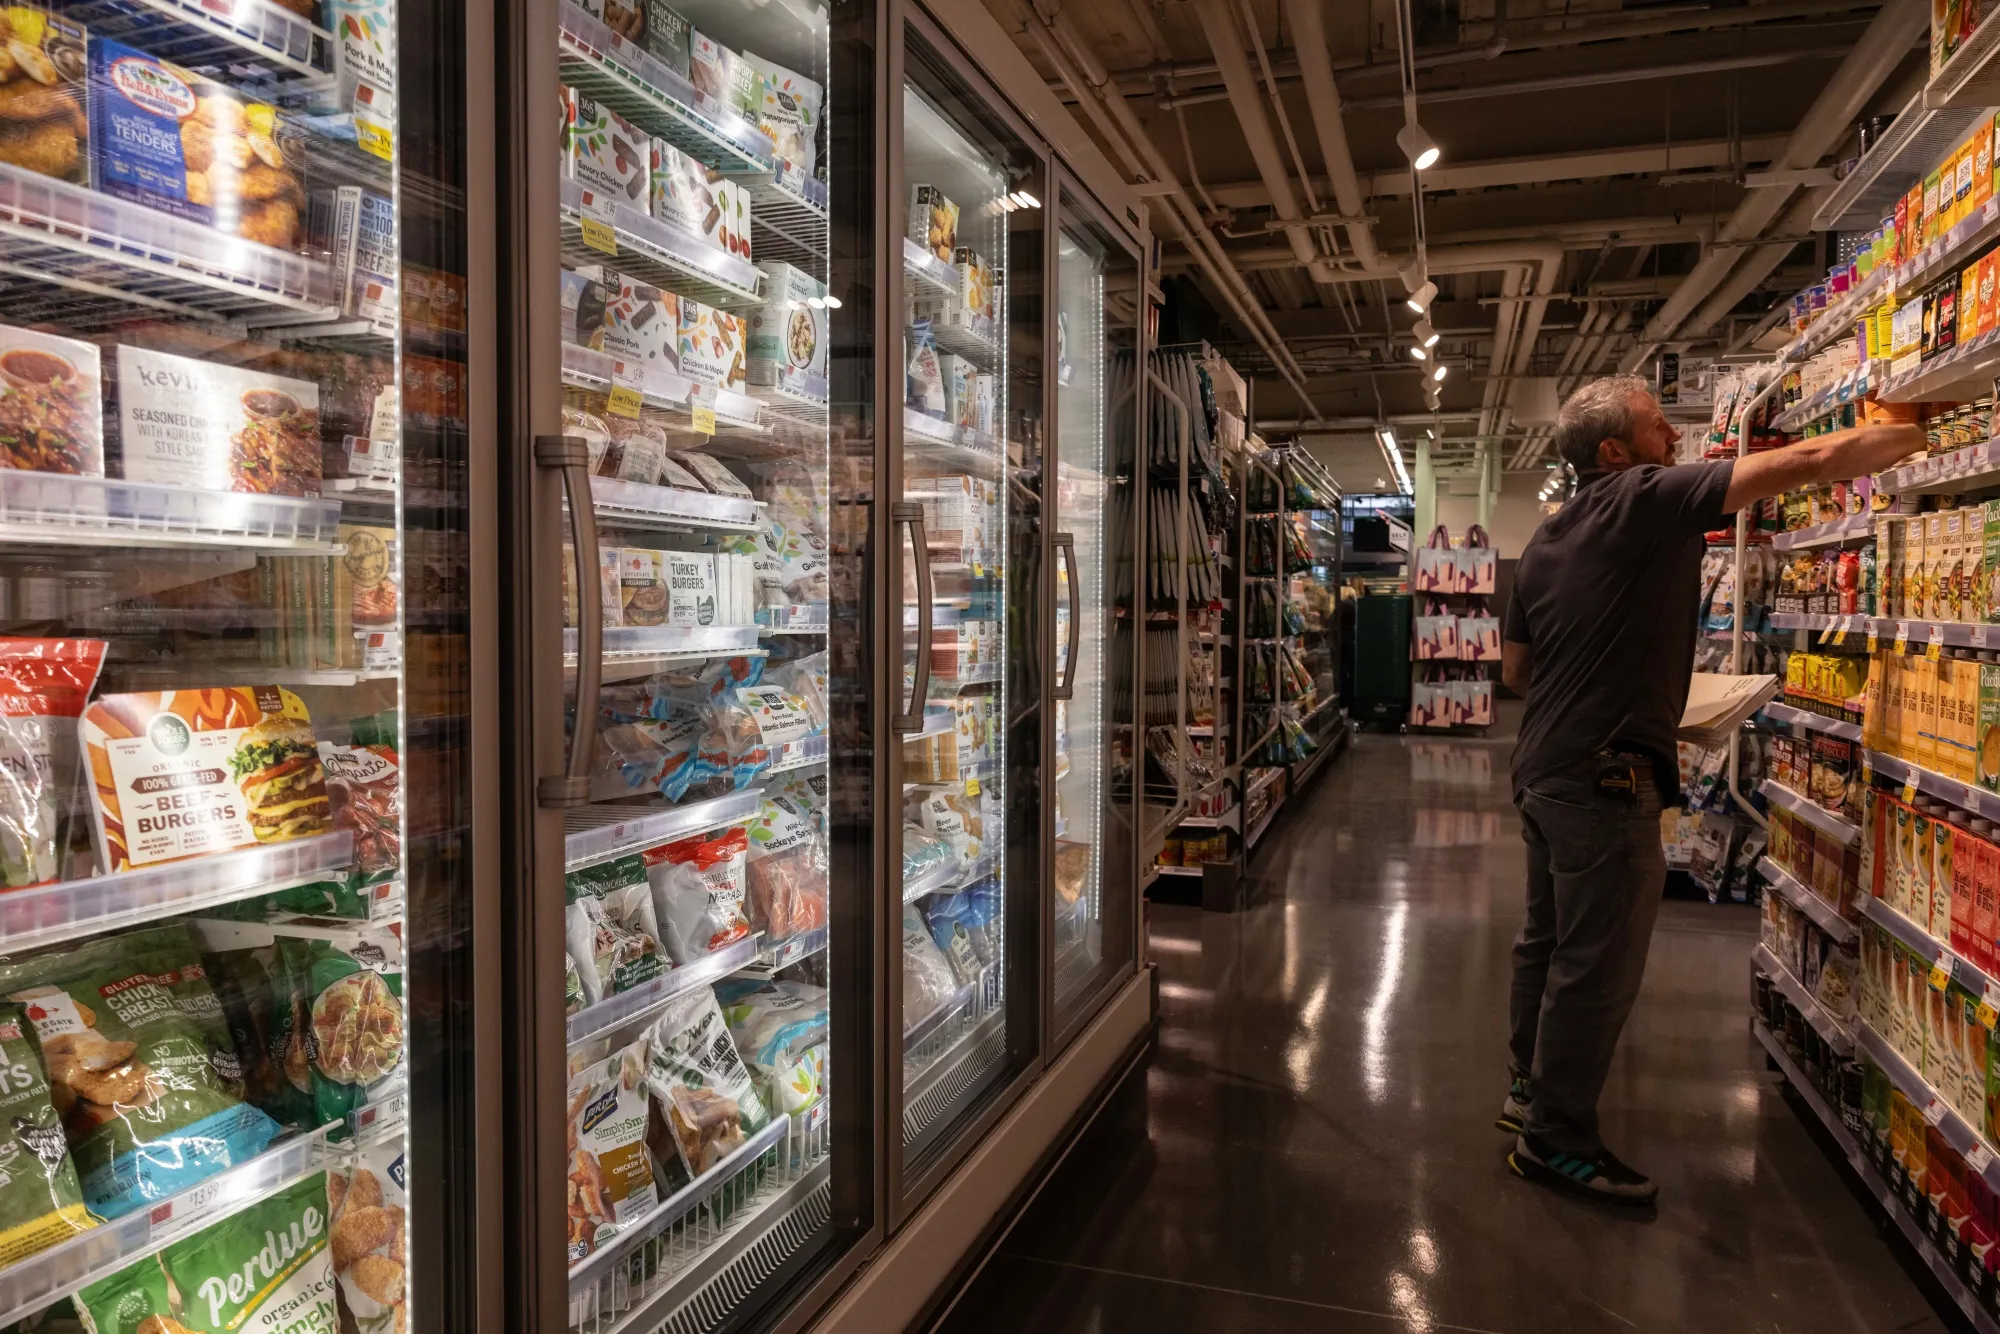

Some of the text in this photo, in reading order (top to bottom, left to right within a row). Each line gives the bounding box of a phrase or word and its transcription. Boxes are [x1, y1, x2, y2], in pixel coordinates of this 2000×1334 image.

[651, 1, 682, 33] CHICKEN
[657, 18, 676, 42] SAGE
[345, 42, 366, 61] Pork
[368, 56, 375, 67] &
[345, 55, 376, 79] Breakfast
[580, 97, 594, 115] 365
[115, 124, 177, 156] TENDERS
[577, 170, 616, 195] Breakfast Sausage
[578, 159, 624, 191] Savory Chicken
[359, 227, 381, 242] GRASS
[356, 248, 384, 272] BEEF
[604, 271, 619, 287] 365
[684, 302, 697, 315] 365
[603, 331, 640, 350] Classic Pork
[603, 342, 642, 359] Breakfast Sausage
[682, 356, 725, 377] Chicken & Maple
[682, 366, 715, 381] Breakfast Sausage
[612, 391, 640, 408] Low Price
[132, 407, 187, 426] SEASONED
[137, 423, 163, 440] WITH
[154, 439, 184, 454] STYLE
[671, 563, 699, 577] TURKEY
[625, 579, 650, 587] ORGANICS
[672, 576, 705, 590] BURGERS
[762, 721, 779, 733] Atlantic
[779, 720, 794, 731] Salmon
[326, 757, 388, 783] Organic
[142, 771, 217, 792] 100% GRASS-FED
[156, 789, 211, 811] BEEF
[136, 804, 237, 834] BURGERS
[936, 817, 952, 828] Beer
[764, 833, 797, 851] Sockeye
[711, 870, 729, 883] FULLY
[116, 996, 173, 1023] BREAST
[127, 1013, 160, 1029] BREADED
[153, 1045, 170, 1057] NO
[613, 1161, 639, 1175] CHICKEN
[597, 1228, 612, 1239] USDA
[198, 1206, 324, 1328] Perdue
[261, 1280, 325, 1326] organic
